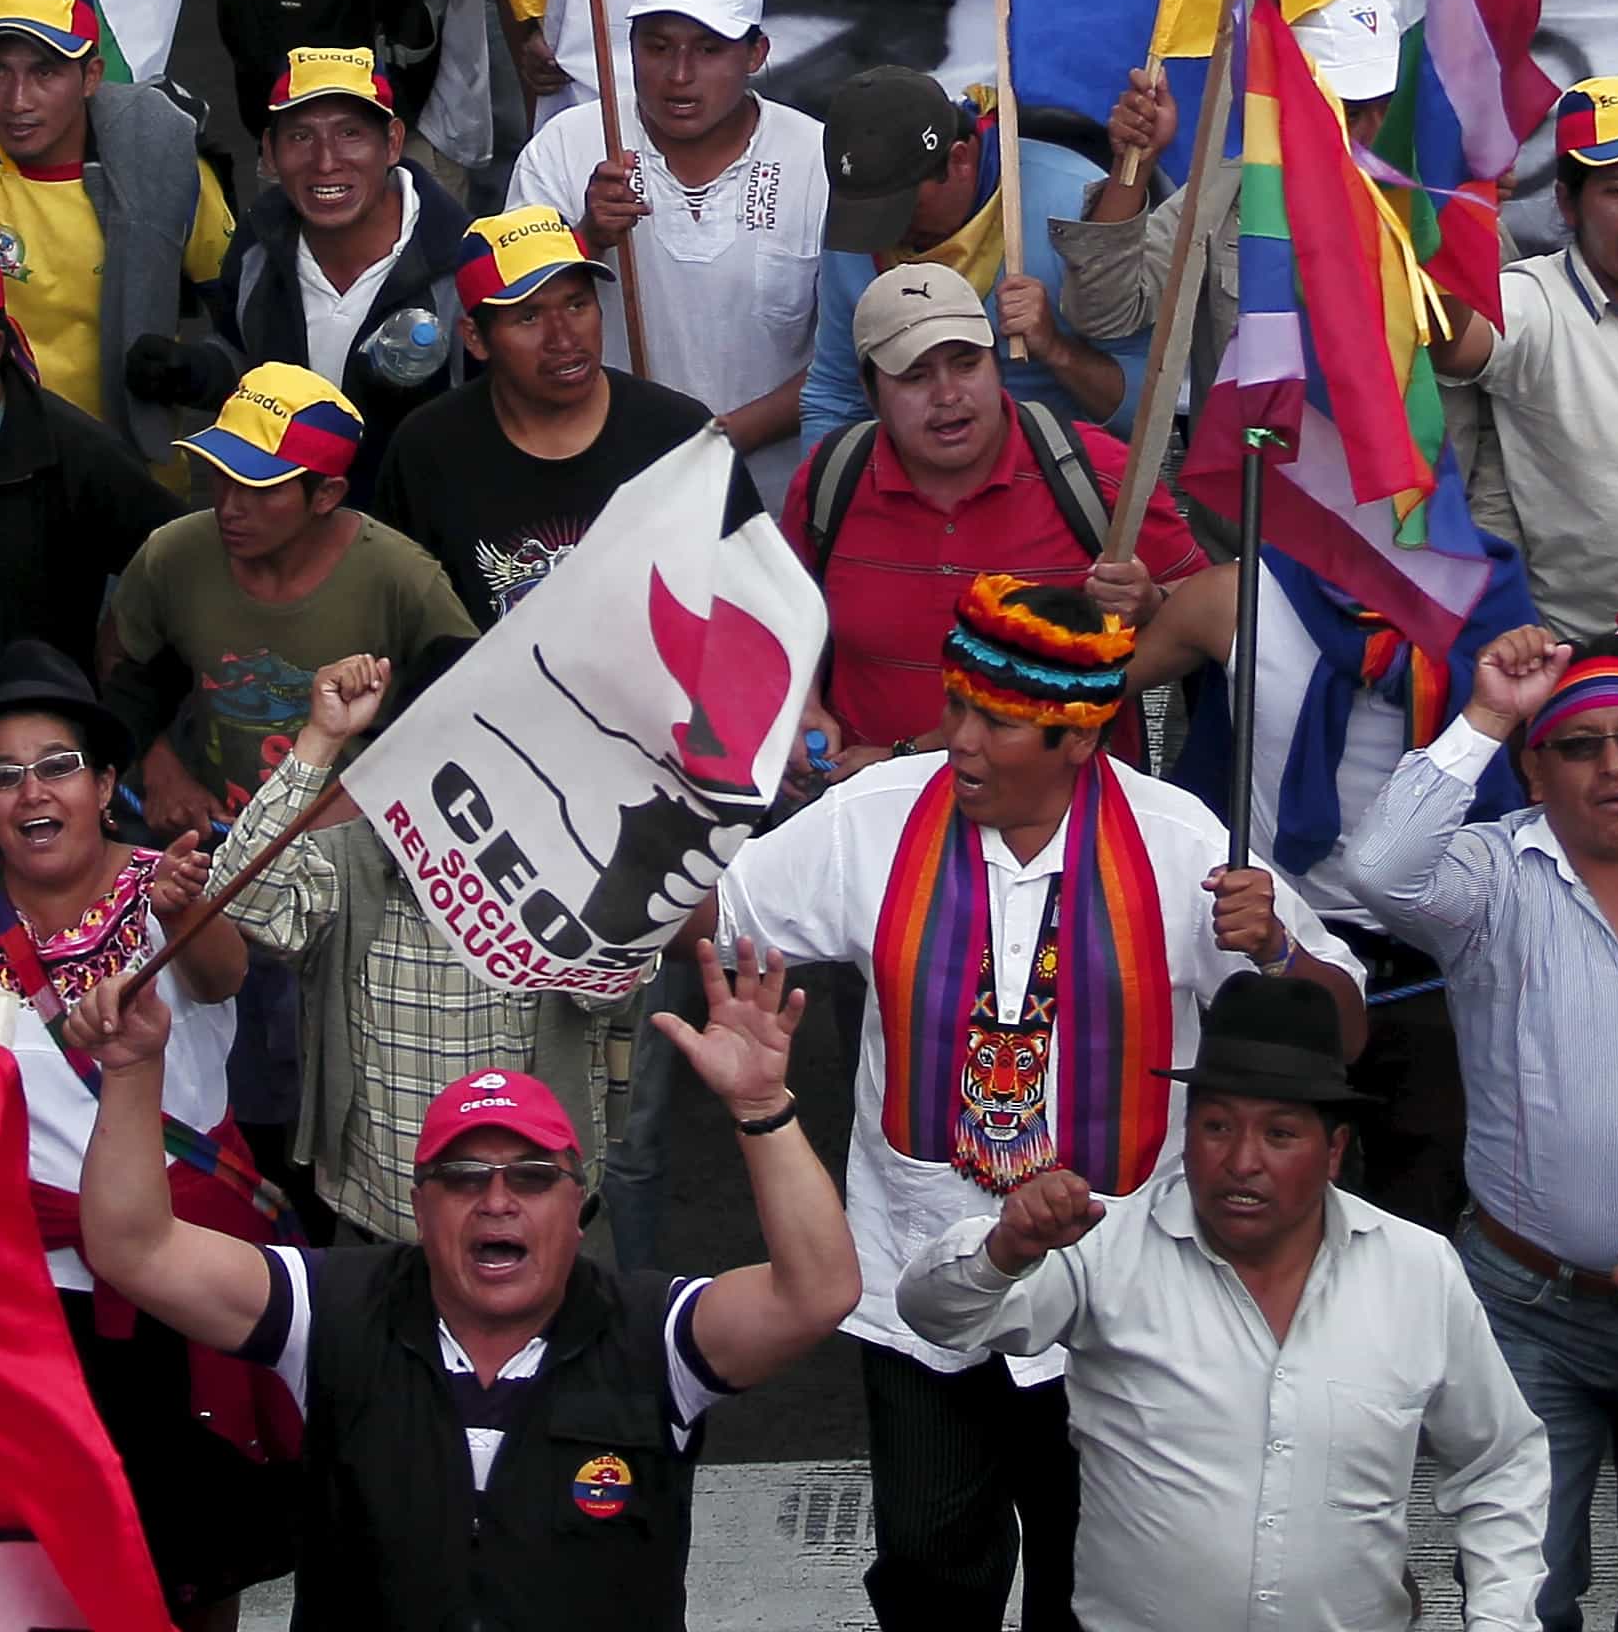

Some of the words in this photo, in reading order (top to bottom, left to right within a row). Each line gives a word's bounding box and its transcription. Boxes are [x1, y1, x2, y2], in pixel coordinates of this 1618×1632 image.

[296, 52, 371, 69] Ecuador
[922, 125, 938, 151] 5
[460, 1098, 519, 1113] CEOSL
